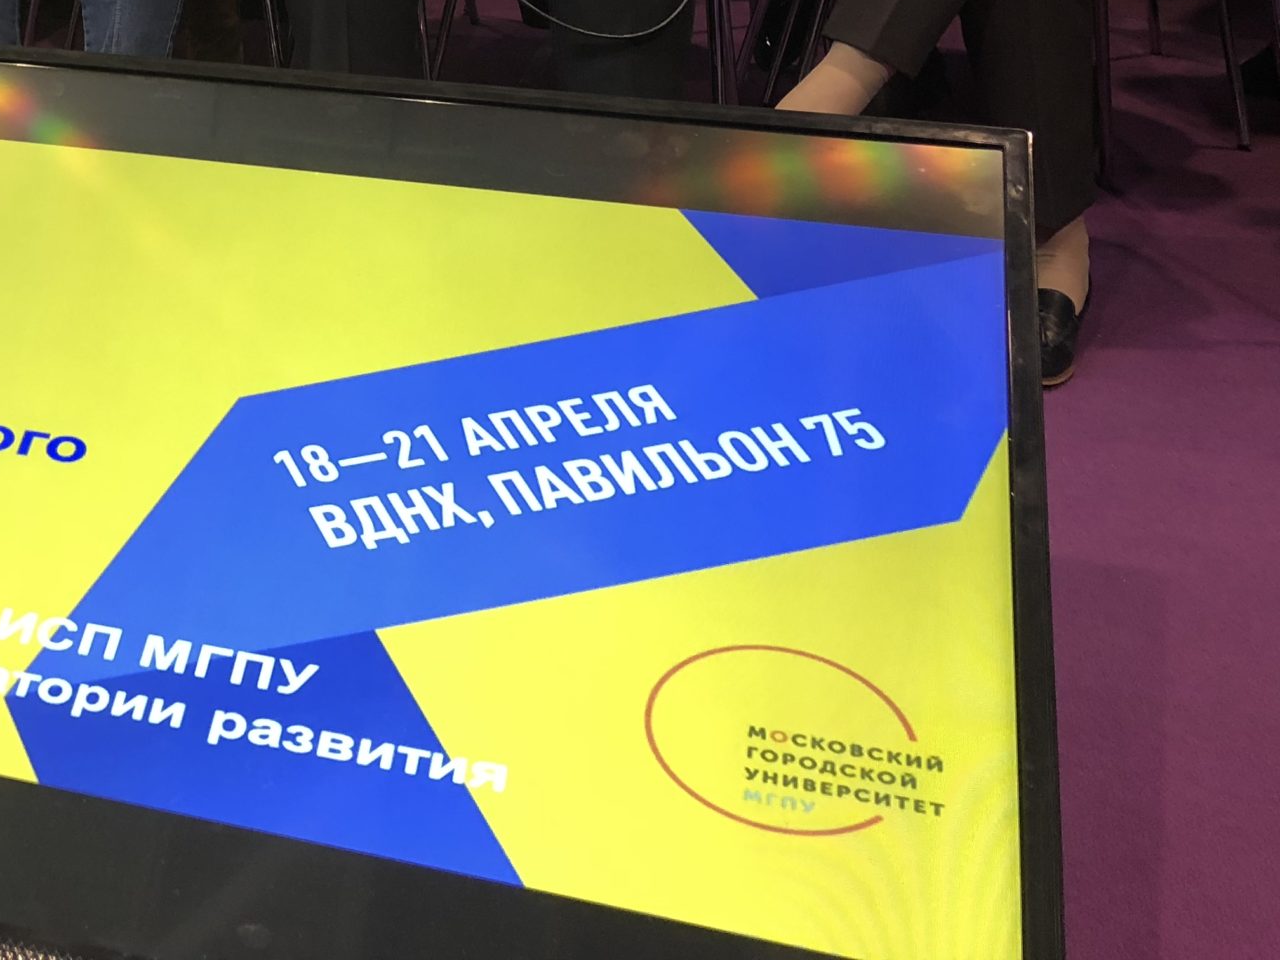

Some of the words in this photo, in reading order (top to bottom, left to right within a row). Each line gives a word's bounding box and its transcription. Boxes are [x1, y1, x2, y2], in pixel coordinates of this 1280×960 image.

[460, 383, 677, 458] АПРЕЛЯ
[308, 481, 495, 550] ВДНХ,
[486, 422, 812, 517] ПАВИЛЬОН
[803, 408, 888, 458] 75
[139, 634, 320, 695] МГПУ
[207, 709, 508, 793] развития
[746, 746, 918, 790] ГОРОДСКОЙ
[748, 725, 944, 773] МОСКОВСКИЙ
[743, 788, 816, 815] МГПУ
[744, 767, 946, 817] УНИВЕРСИТЕТ
